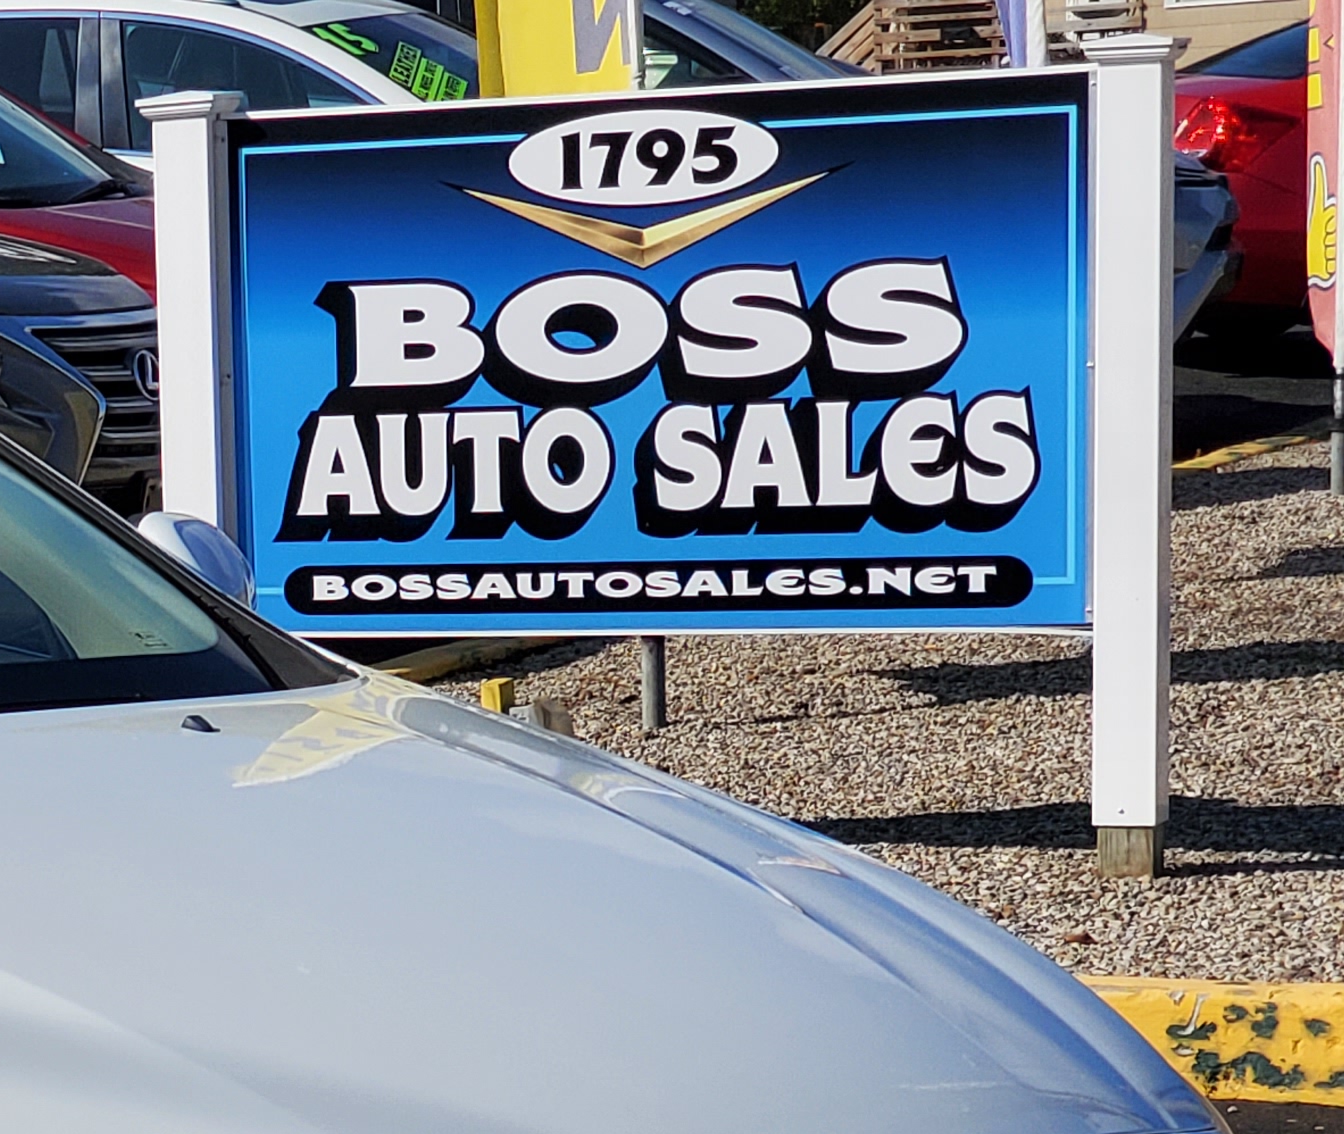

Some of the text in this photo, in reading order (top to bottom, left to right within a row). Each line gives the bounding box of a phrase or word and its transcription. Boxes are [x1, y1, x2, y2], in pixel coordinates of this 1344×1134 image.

[313, 23, 379, 55] 15
[560, 126, 739, 190] 1795
[349, 263, 963, 387] BOSS
[296, 396, 1035, 516] AUTO SALES
[313, 565, 997, 601] BOSSAUTOSALES.NET
